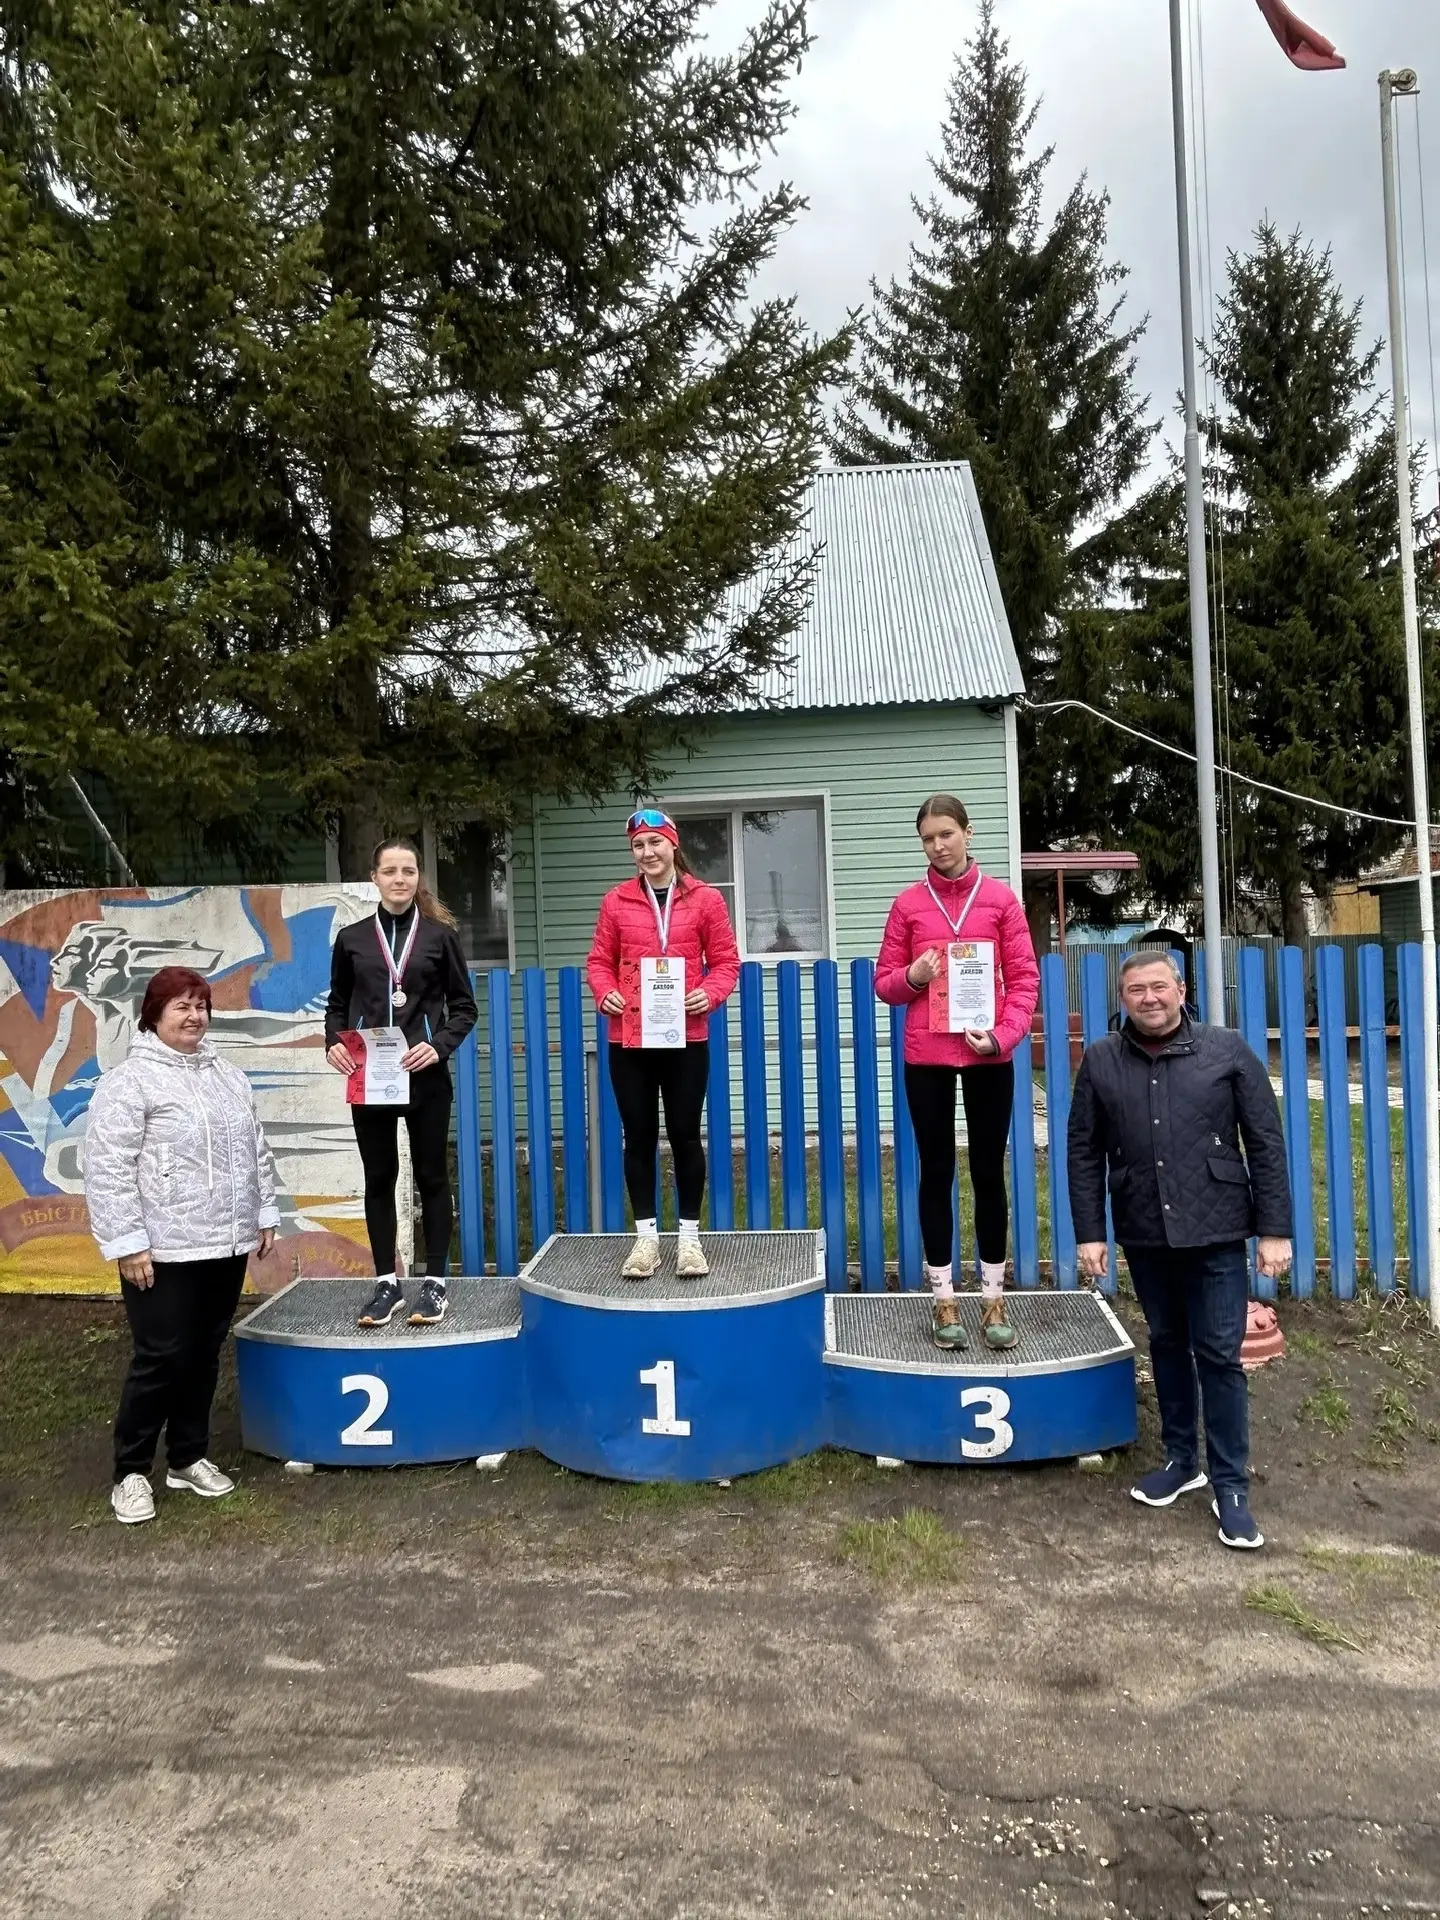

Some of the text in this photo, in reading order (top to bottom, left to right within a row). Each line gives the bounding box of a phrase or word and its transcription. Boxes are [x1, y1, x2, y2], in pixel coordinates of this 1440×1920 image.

[341, 1374, 393, 1445] 2
[640, 1360, 690, 1436] 1
[961, 1386, 1013, 1458] 3
